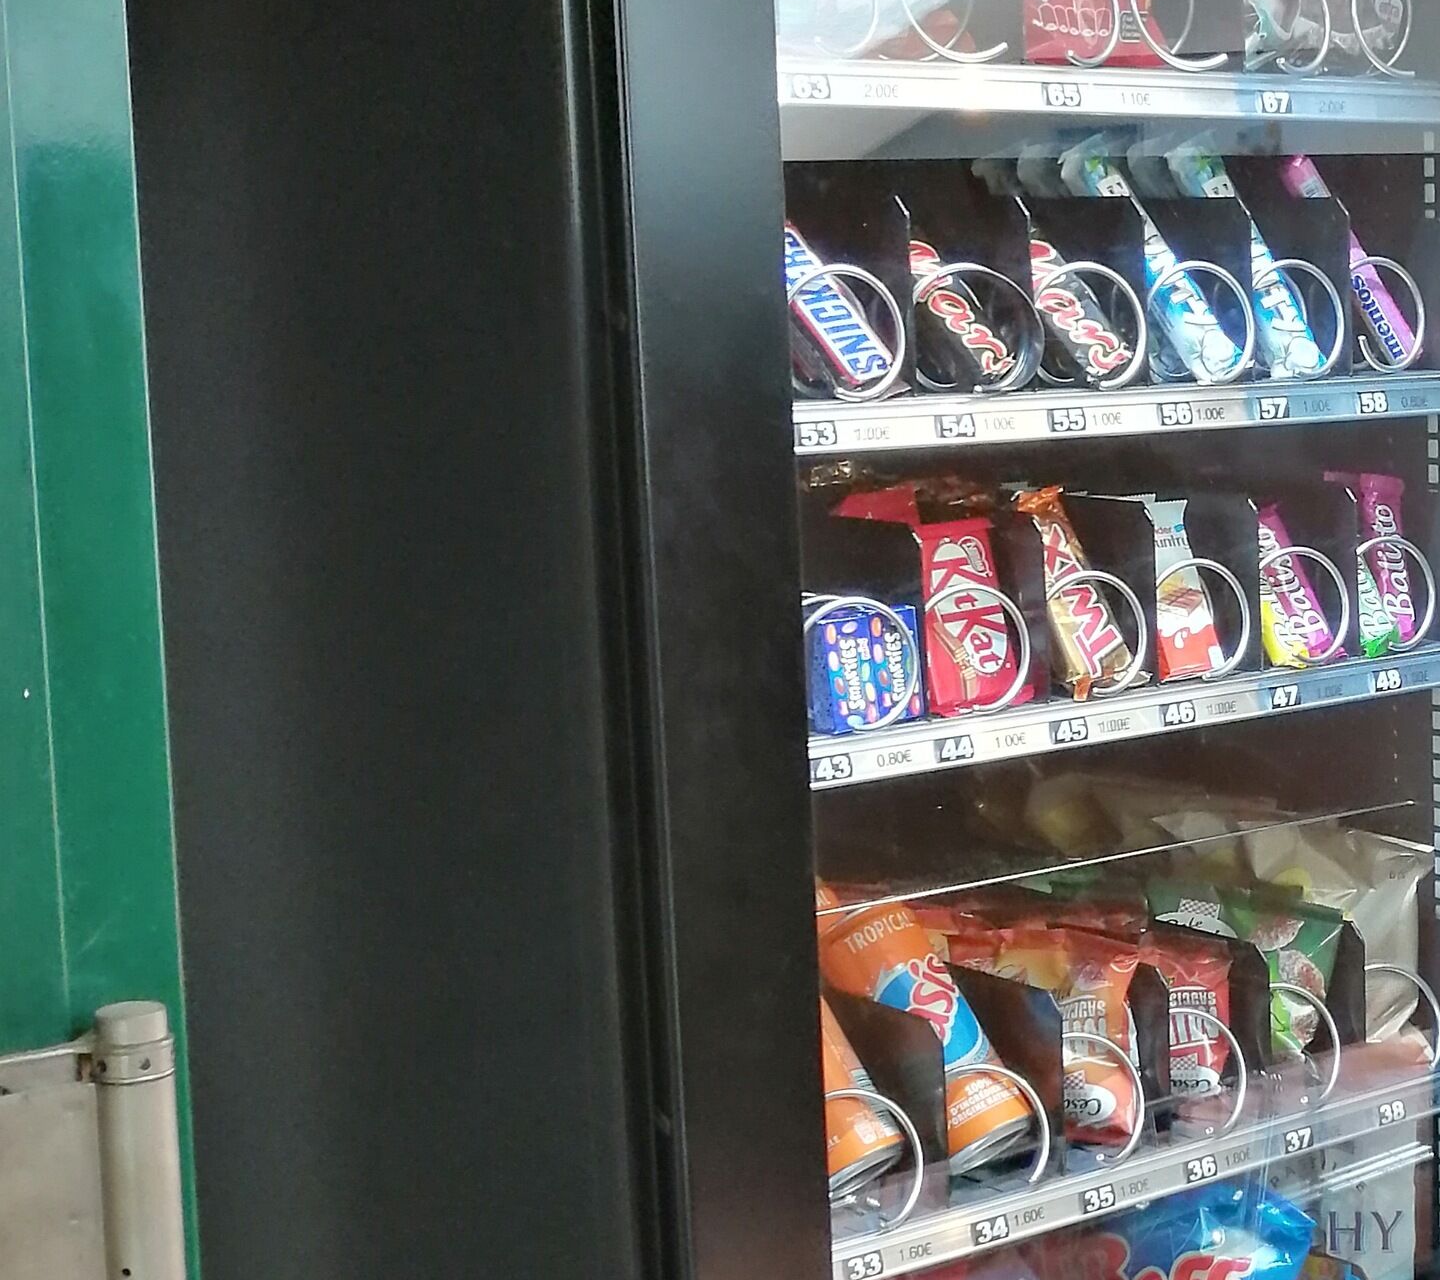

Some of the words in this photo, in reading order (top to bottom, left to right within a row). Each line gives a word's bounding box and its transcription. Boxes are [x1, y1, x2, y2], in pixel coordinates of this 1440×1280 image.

[1049, 83, 1081, 107] 65
[1261, 90, 1290, 113] 67
[1352, 273, 1406, 362] mentos
[1160, 403, 1193, 425] 56
[1196, 407, 1226, 421] 1.00€
[1258, 396, 1289, 421] 57
[1359, 392, 1389, 414] 58
[940, 414, 976, 439] 54
[1051, 408, 1086, 432] 55
[800, 422, 837, 447] 53
[929, 555, 1008, 670] KtKat
[1375, 670, 1402, 691] 48
[1271, 686, 1299, 707] 47
[1164, 701, 1196, 725] 46
[1056, 719, 1088, 742] 45
[941, 736, 974, 760] 44
[815, 756, 851, 780] 43
[876, 751, 912, 768] 0.80€
[843, 910, 915, 955] TROPICAL
[1380, 1101, 1406, 1124] 38
[1285, 1128, 1314, 1152] 37
[1187, 1156, 1217, 1183] 36
[1084, 1186, 1115, 1210] 35
[1119, 1178, 1149, 1199] 1.80€
[975, 1215, 1009, 1243] 34
[1013, 1206, 1045, 1227] 1.60€
[847, 1251, 883, 1280] 33
[899, 1242, 932, 1261] 1.60€
